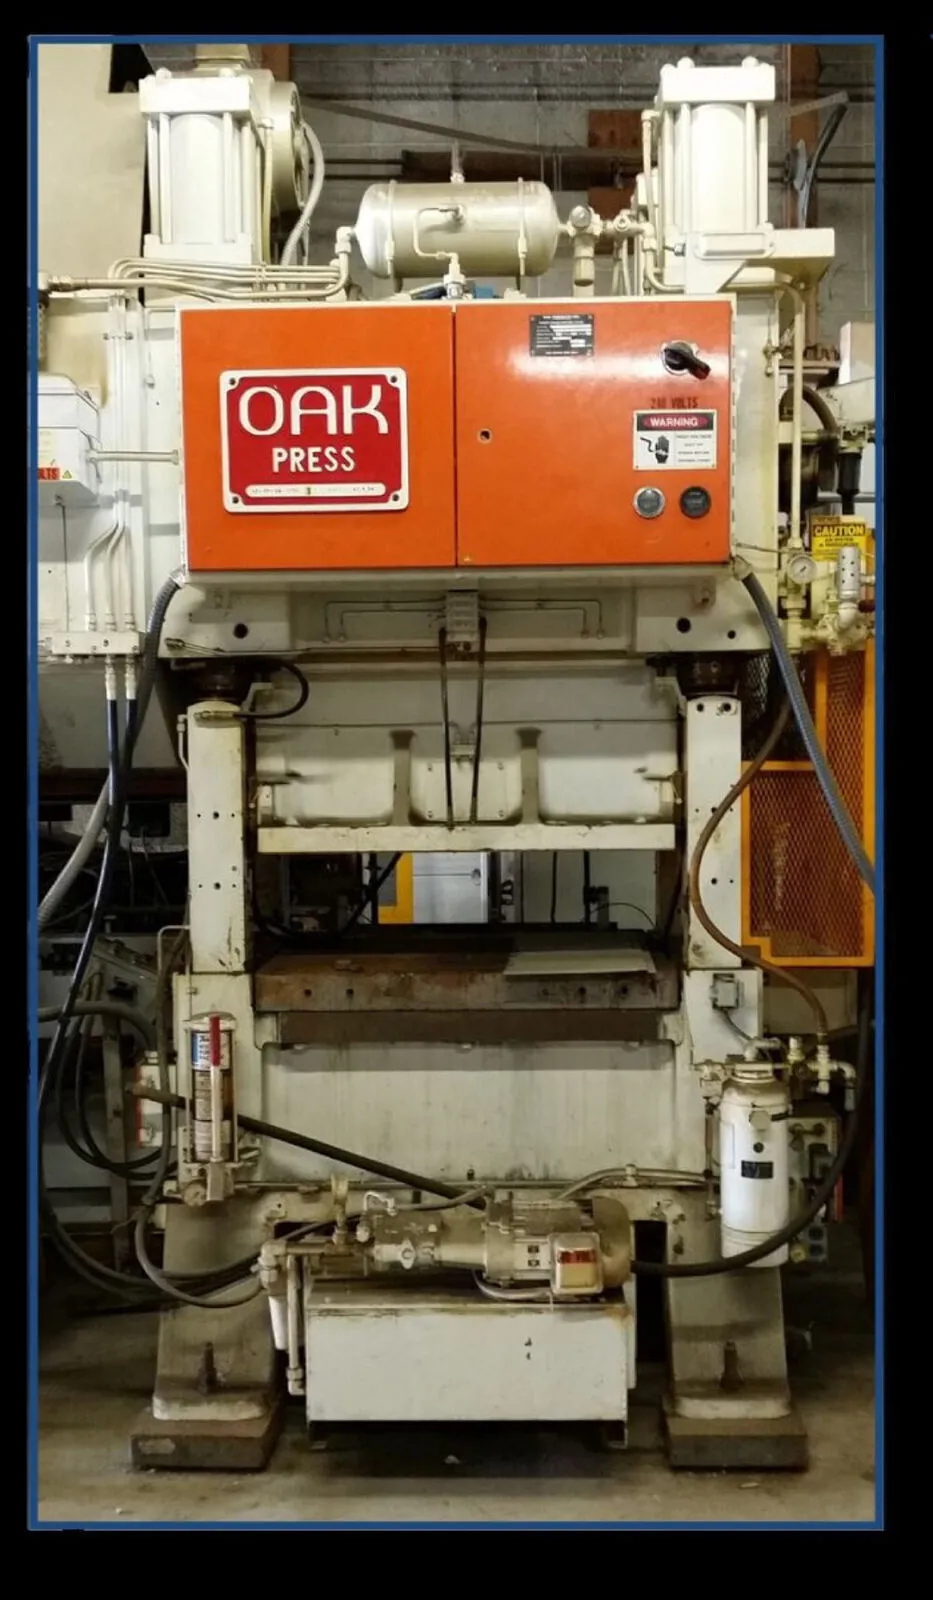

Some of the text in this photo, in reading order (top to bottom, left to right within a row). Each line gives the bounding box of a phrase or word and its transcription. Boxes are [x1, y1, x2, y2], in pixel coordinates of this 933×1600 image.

[671, 396, 699, 409] VOLTS
[239, 385, 389, 436] OAK
[650, 416, 699, 427] WARNING
[272, 446, 355, 473] PRESS
[814, 525, 864, 536] CAUTION
